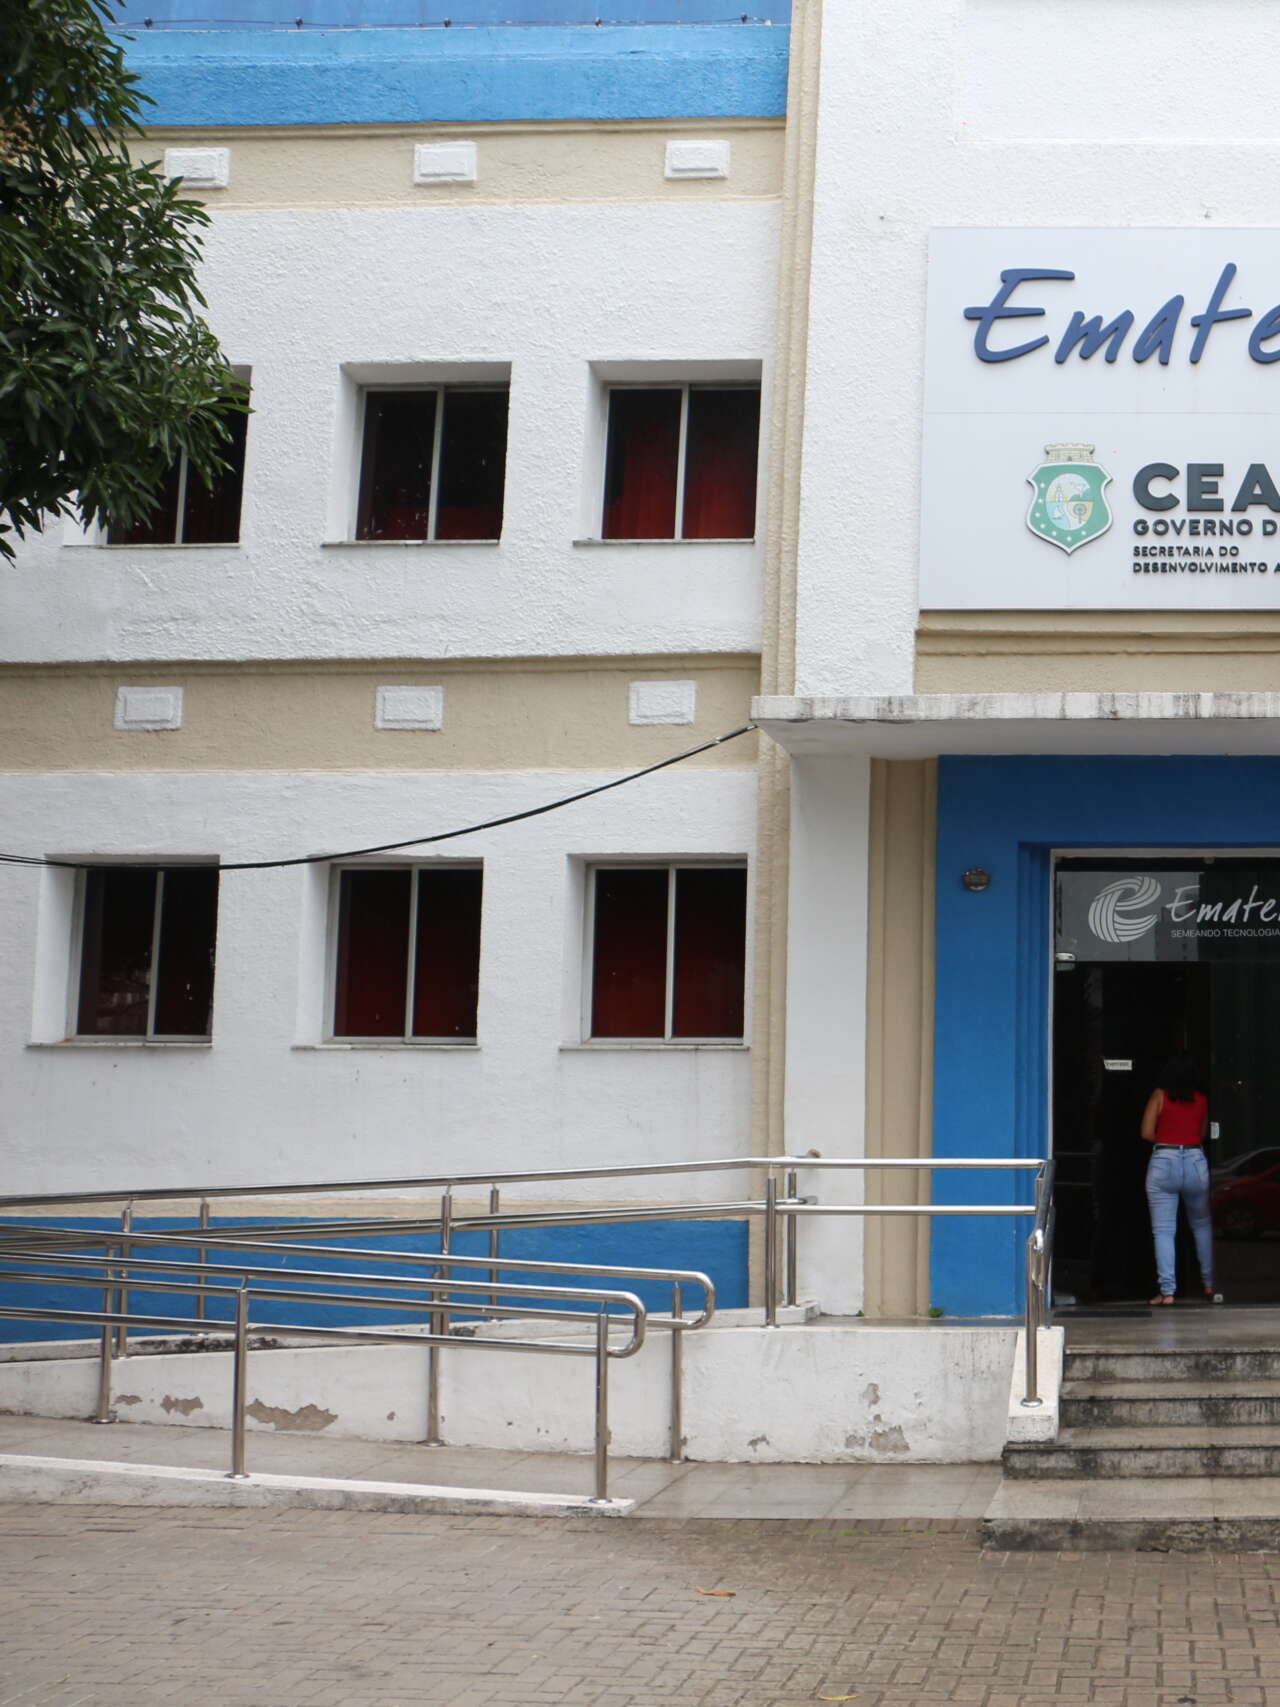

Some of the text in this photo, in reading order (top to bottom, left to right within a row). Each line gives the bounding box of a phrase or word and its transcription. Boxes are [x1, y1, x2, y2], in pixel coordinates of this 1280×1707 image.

[1132, 518, 1254, 537] GOVERNO
[1132, 545, 1240, 558] SECRETARIA DO
[1132, 561, 1268, 574] DESENVOLVIMENTO
[1170, 928, 1221, 938] SEMEANDO
[1223, 927, 1280, 938] TECNOLOGIA
